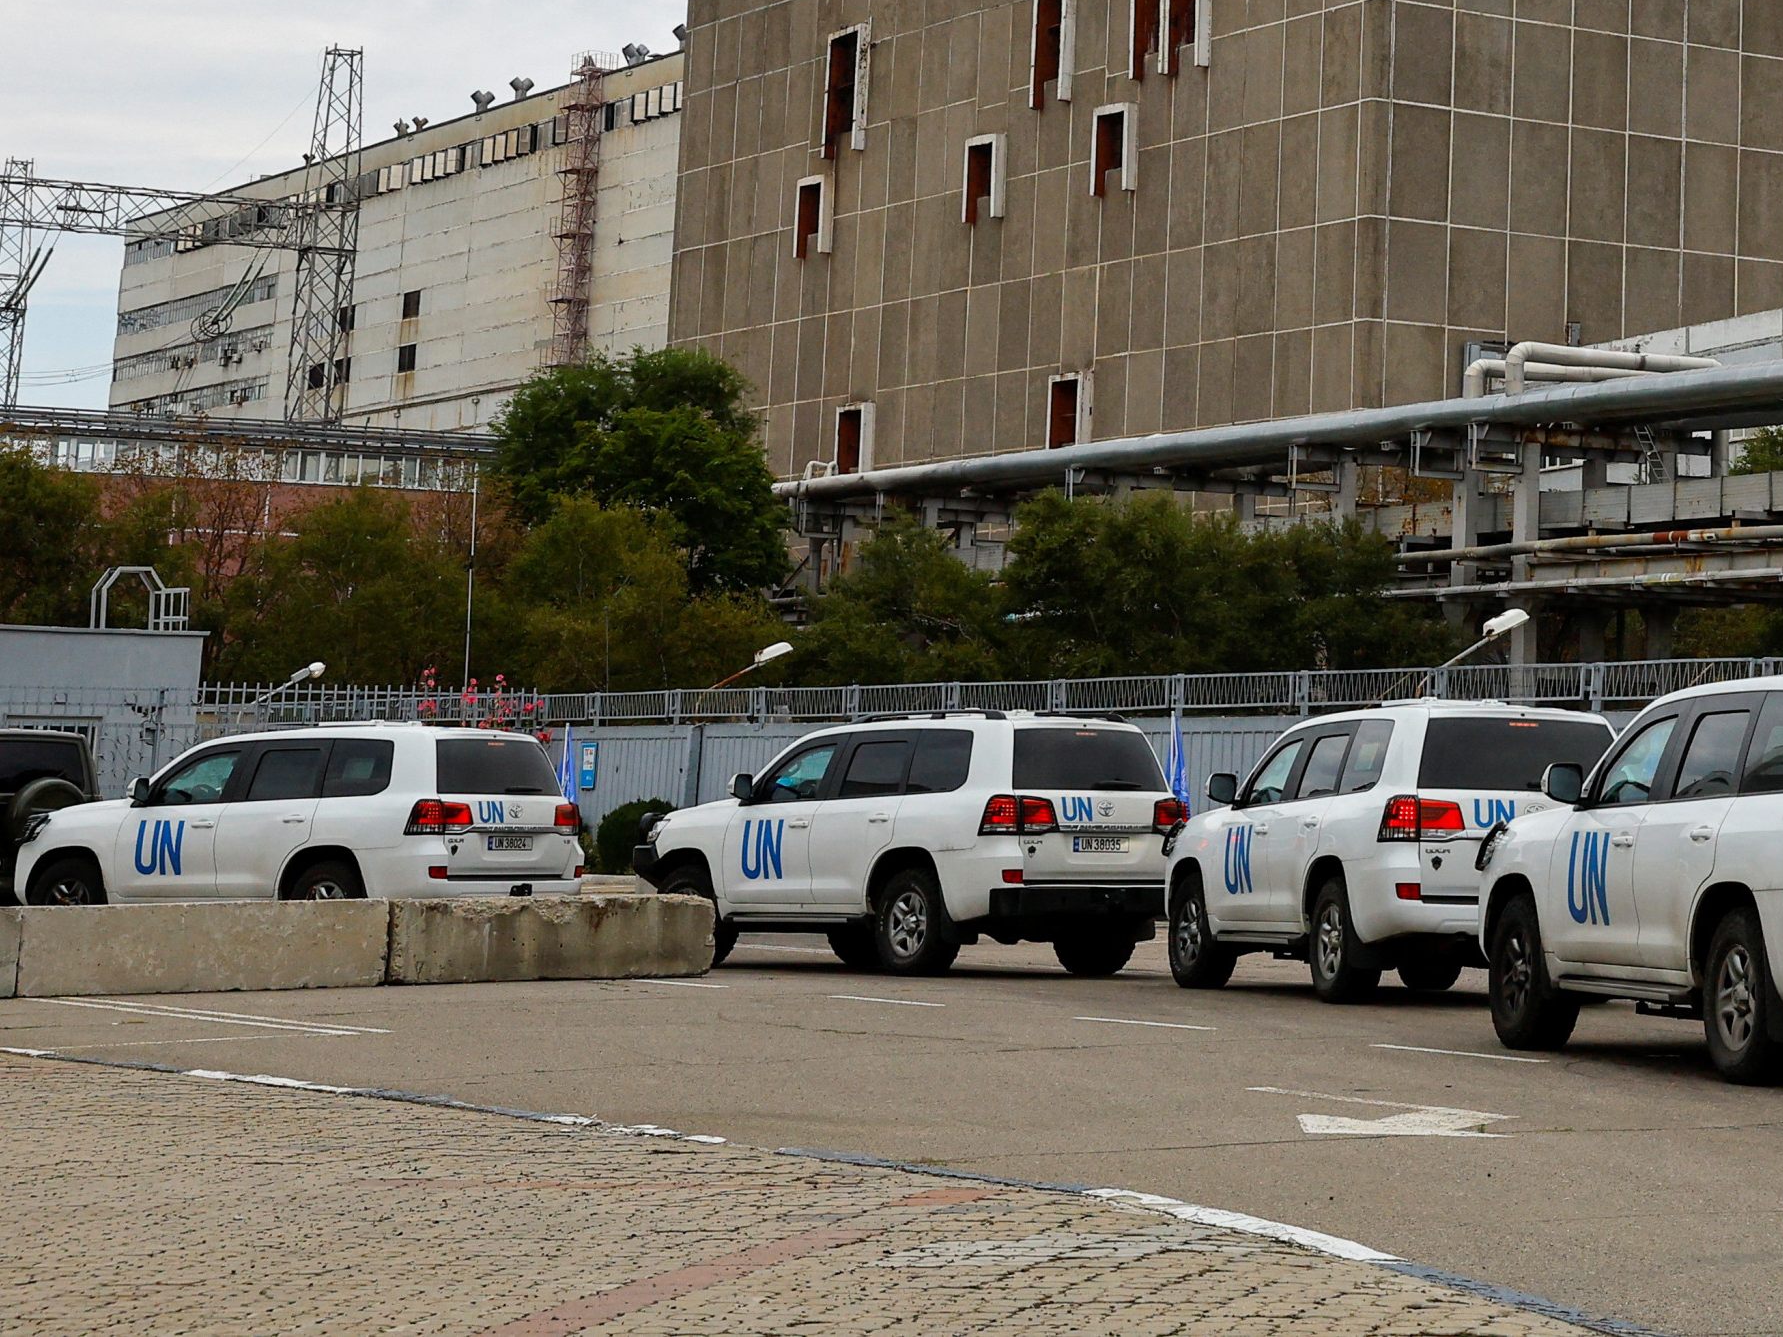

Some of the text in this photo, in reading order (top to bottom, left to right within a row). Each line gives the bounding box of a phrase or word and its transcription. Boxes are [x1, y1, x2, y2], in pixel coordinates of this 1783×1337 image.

[478, 801, 504, 823] UN
[1061, 797, 1093, 822] UN
[1474, 799, 1515, 828] UN
[135, 820, 185, 875] UN
[494, 837, 527, 849] UN 38024
[741, 819, 784, 879] UN
[1082, 837, 1121, 852] UN 38035
[1225, 825, 1253, 895] UN
[1568, 831, 1610, 926] UN
